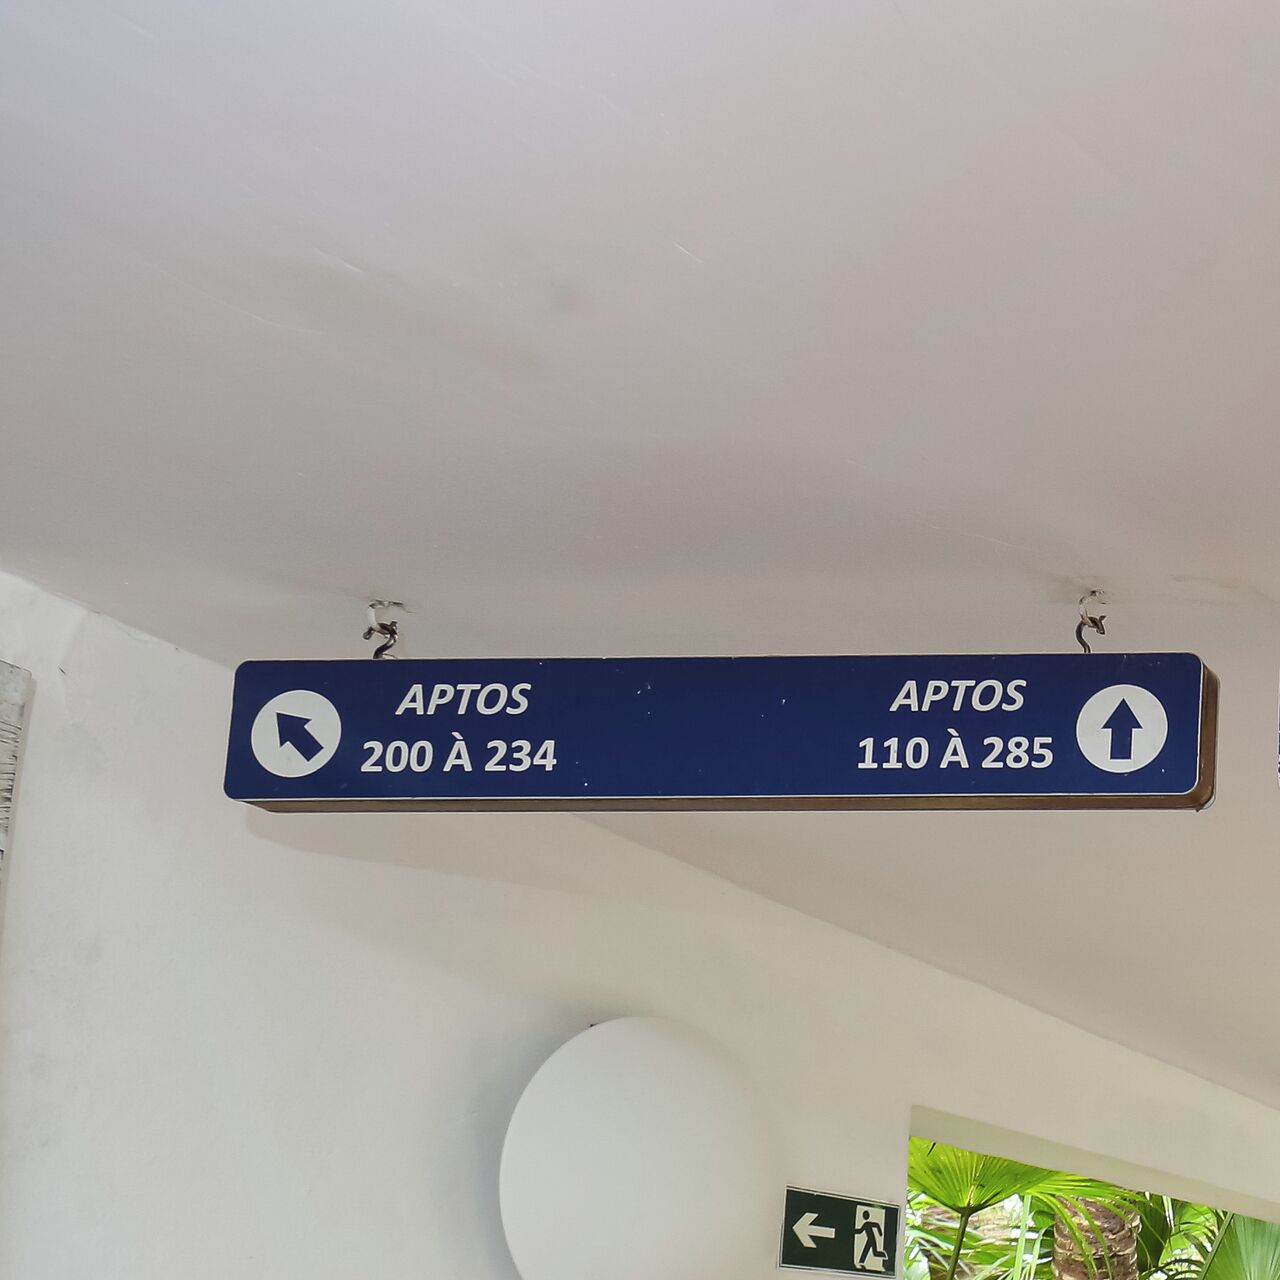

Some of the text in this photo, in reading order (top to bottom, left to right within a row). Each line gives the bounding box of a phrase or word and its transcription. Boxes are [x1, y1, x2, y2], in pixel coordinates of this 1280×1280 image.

[394, 682, 532, 715] APTOS
[889, 679, 1027, 712] APTOS
[360, 731, 557, 773] 200 À 234
[857, 728, 1054, 769] 110 À 285
